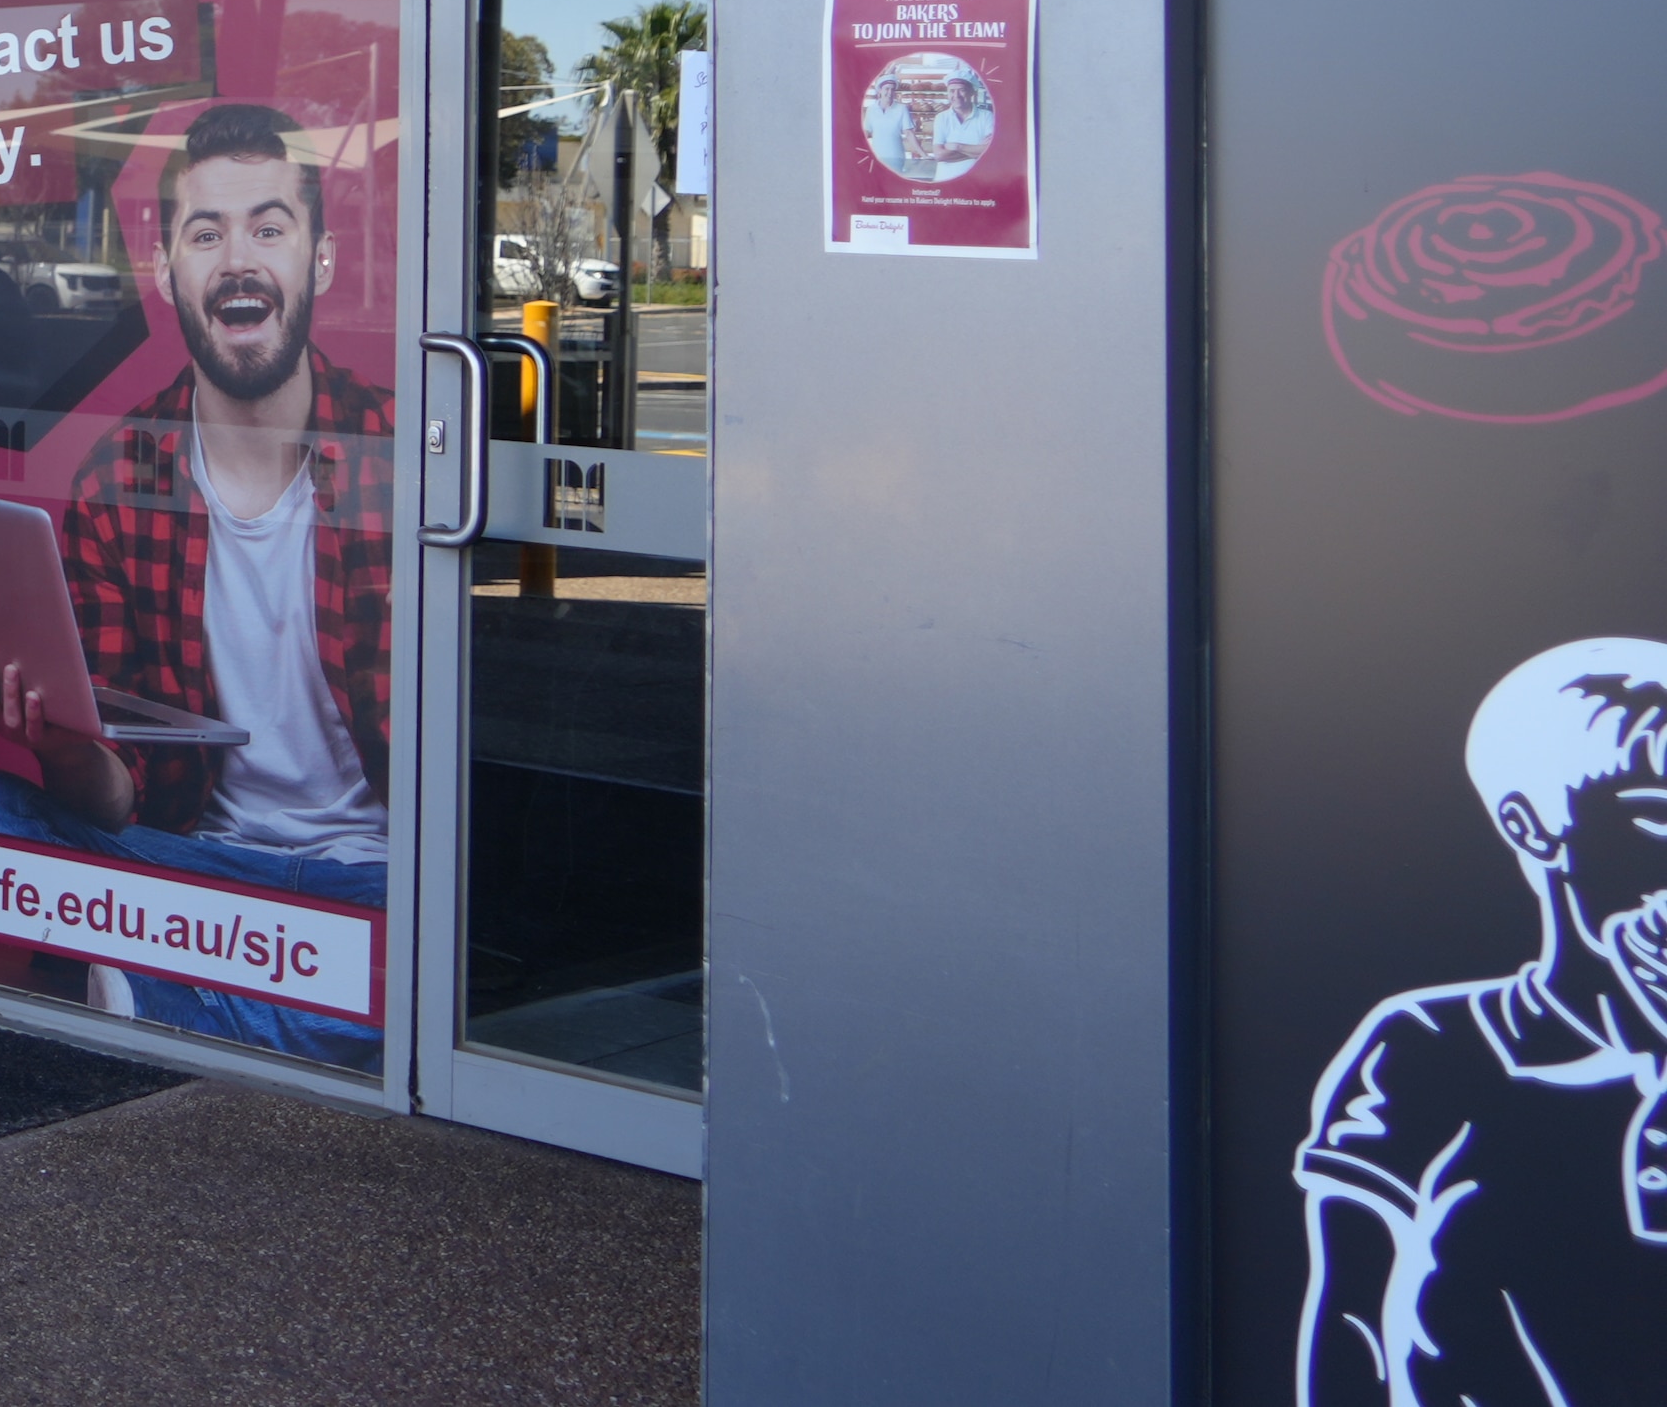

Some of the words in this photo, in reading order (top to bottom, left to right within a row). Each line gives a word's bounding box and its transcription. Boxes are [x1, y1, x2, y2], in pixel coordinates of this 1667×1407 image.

[896, 3, 958, 22] BAKERS
[100, 14, 174, 65] us
[852, 23, 873, 39] TO
[874, 23, 912, 42] JOIN
[916, 22, 947, 39] THE
[952, 22, 1006, 38] TEAM!
[934, 197, 952, 206] Delight
